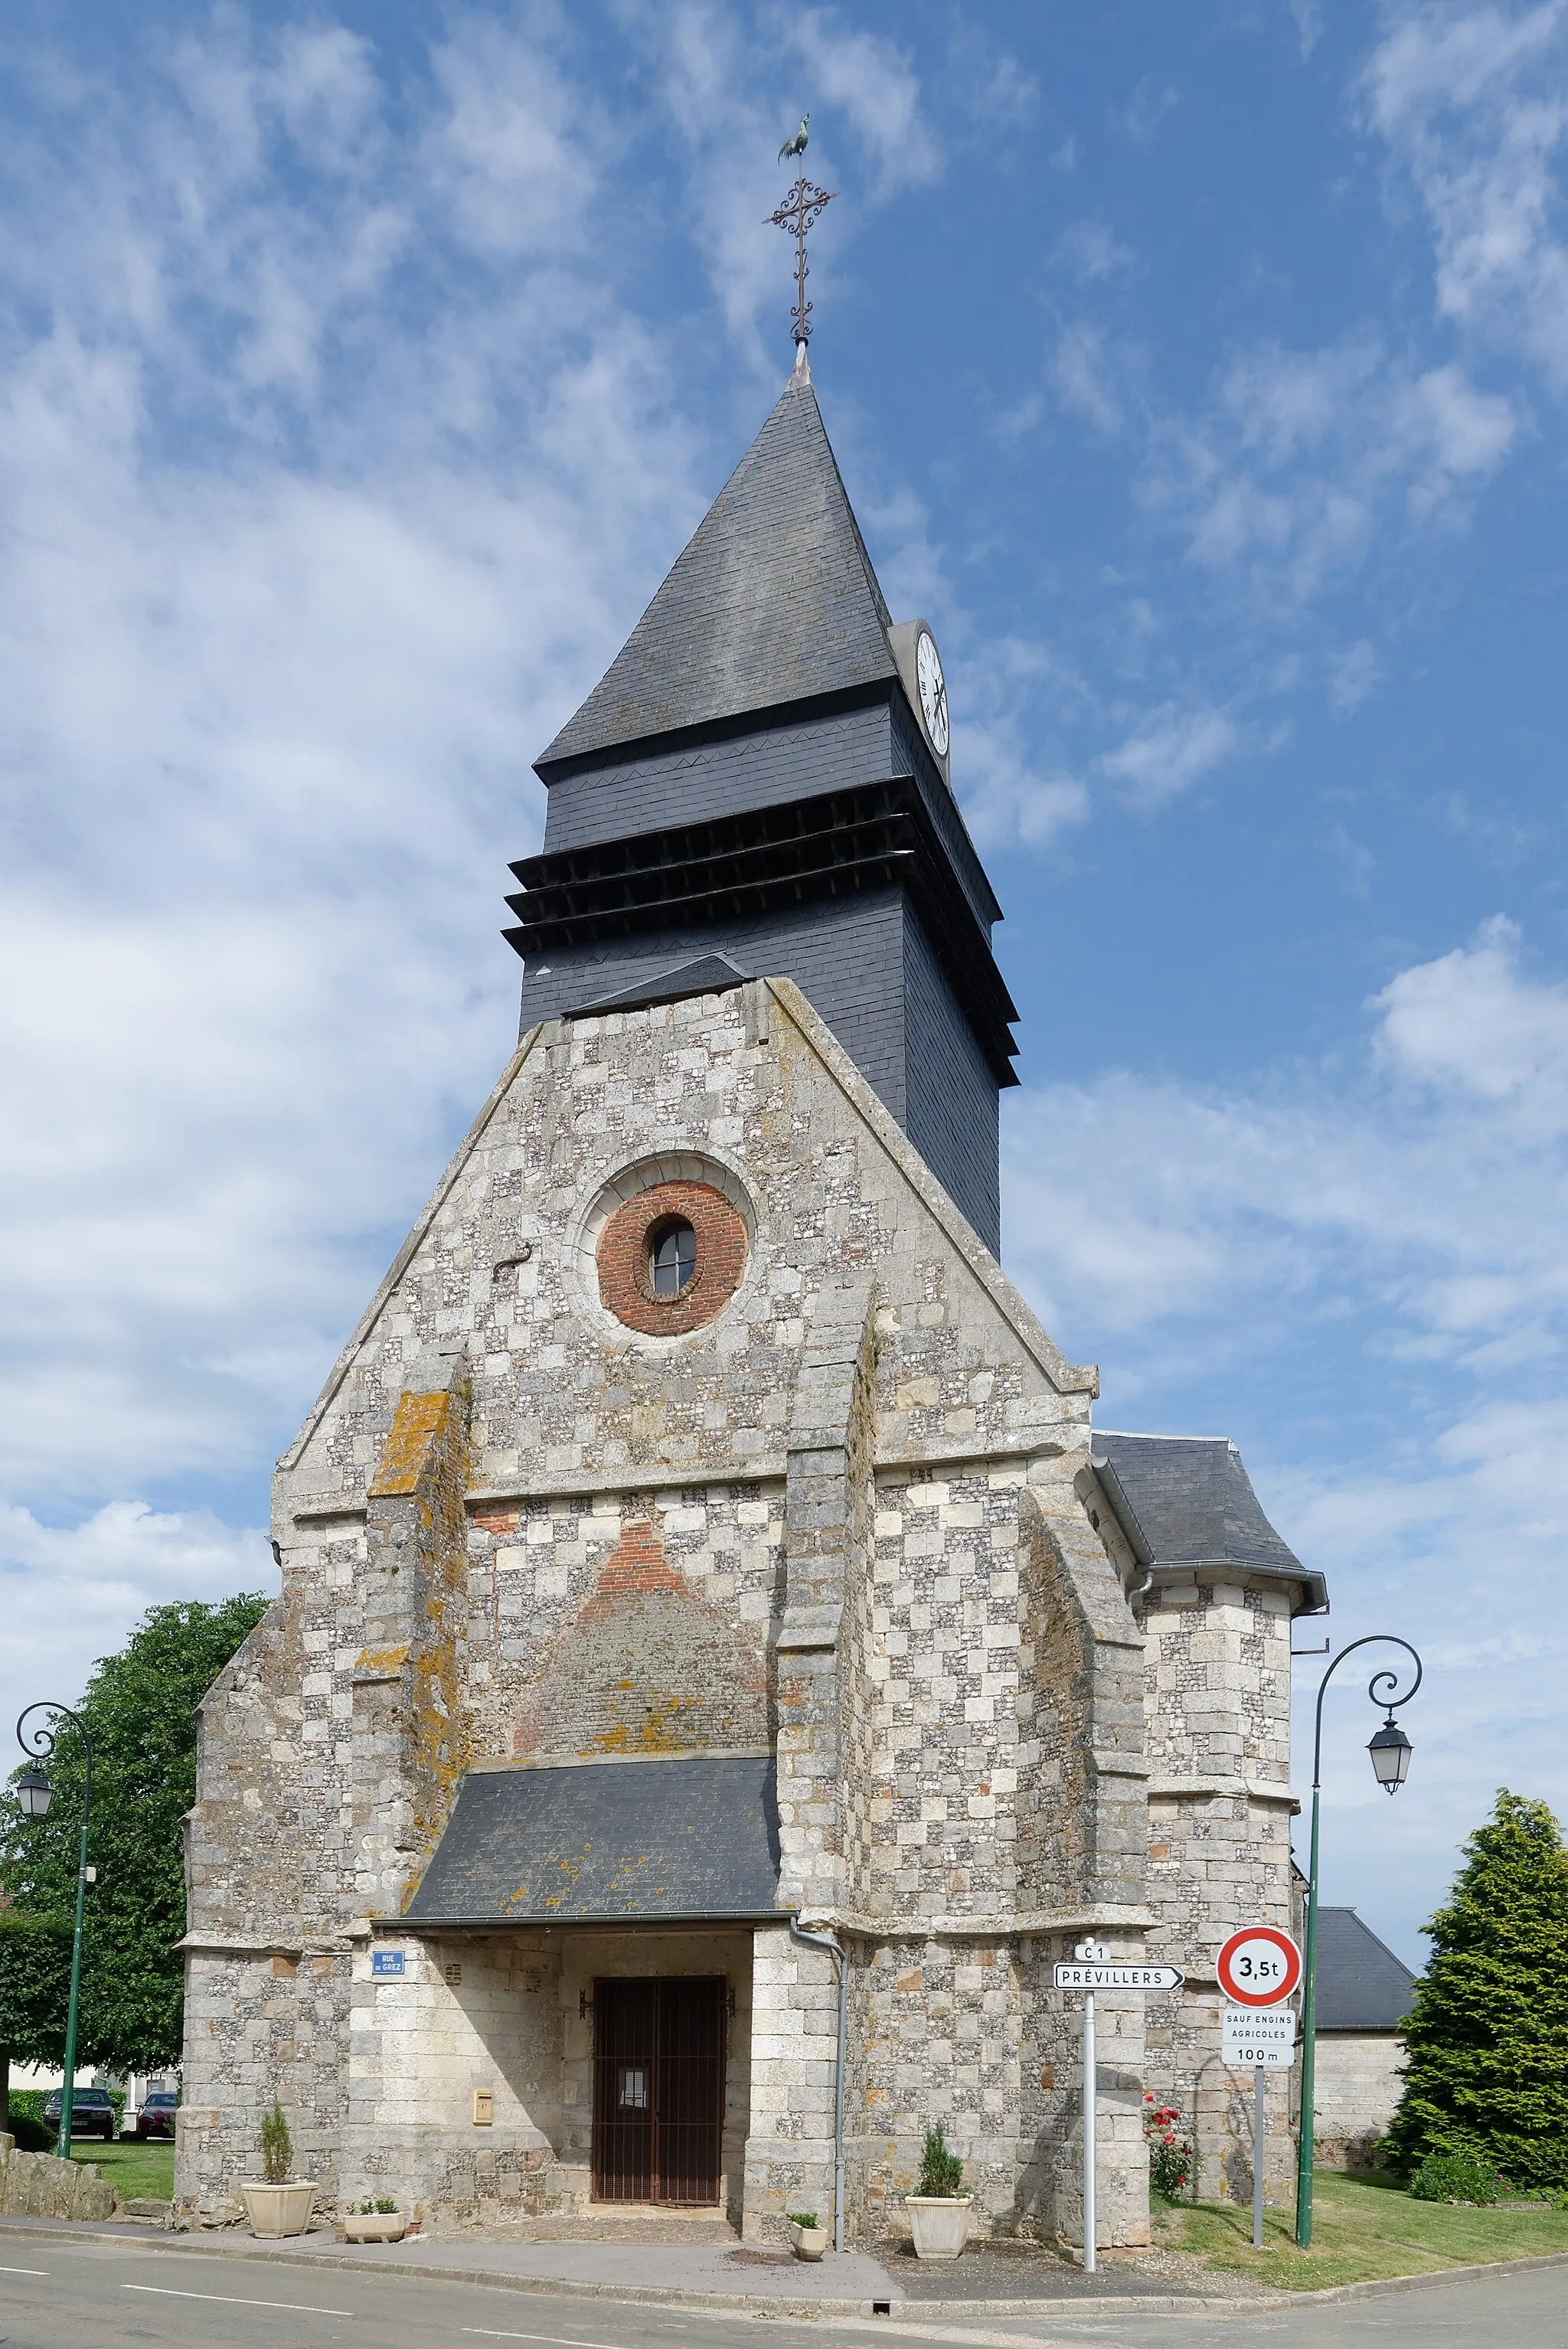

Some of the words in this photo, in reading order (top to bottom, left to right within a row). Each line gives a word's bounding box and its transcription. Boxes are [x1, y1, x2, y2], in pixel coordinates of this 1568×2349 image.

[1085, 1947, 1093, 1959] C
[1098, 1947, 1103, 1959] 1
[1062, 1968, 1162, 1984] PRÉVILLERS
[1232, 2030, 1285, 2038] AGRICOLES
[1237, 2049, 1265, 2060] 100
